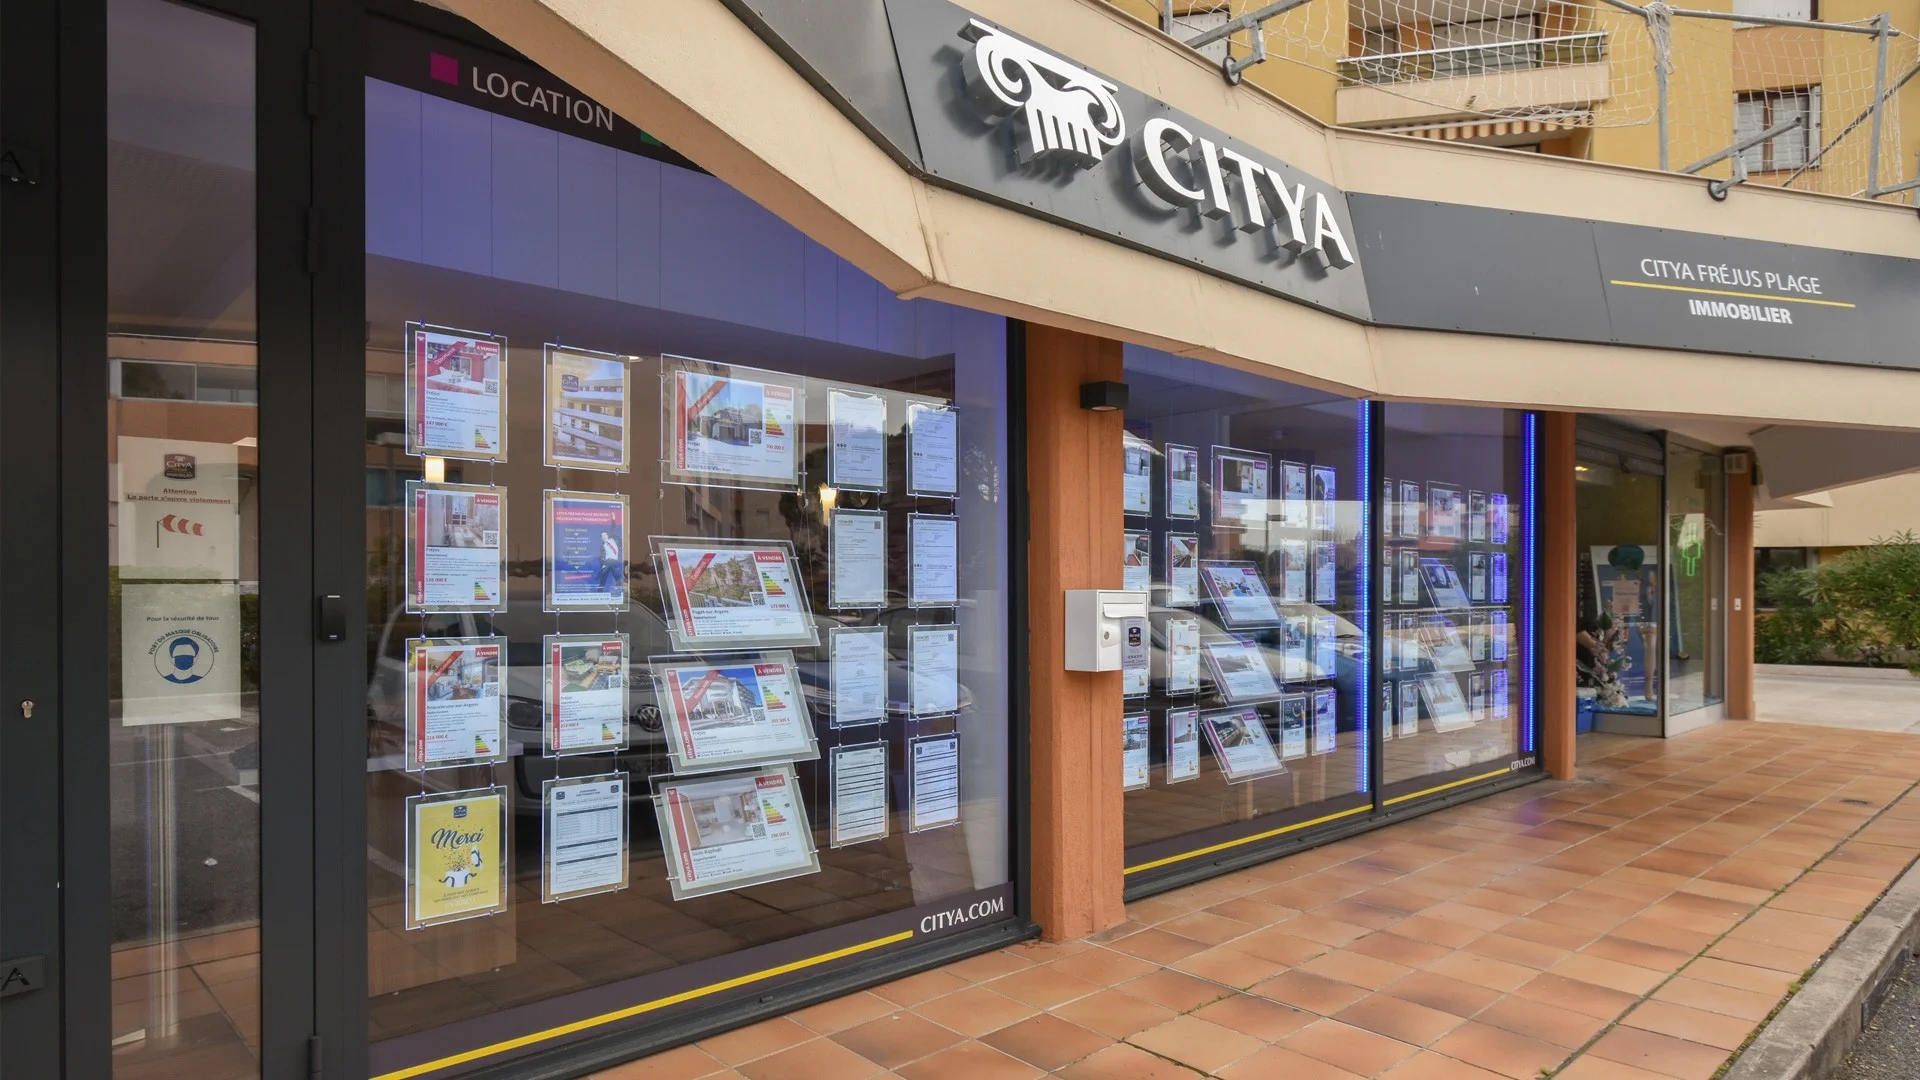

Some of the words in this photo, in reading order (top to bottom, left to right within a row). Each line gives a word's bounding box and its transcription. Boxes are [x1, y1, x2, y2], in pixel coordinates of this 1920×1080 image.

[472, 66, 613, 131] LOCATION
[1134, 117, 1355, 269] CITYA
[1640, 258, 1694, 281] CITYA
[1699, 263, 1762, 288] FRÉJUS
[1766, 272, 1822, 295] PLAGE
[1688, 299, 1793, 325] IMMOBILIER
[166, 460, 193, 468] CITYA
[161, 495, 188, 503] s'ouvre
[165, 629, 191, 637] MASQUE
[190, 629, 220, 653] OBLIGATOIRE
[683, 731, 693, 759] citya.com
[431, 828, 484, 849] Merci
[682, 852, 692, 881] citya.com
[920, 896, 1004, 934] CITYA.COM
